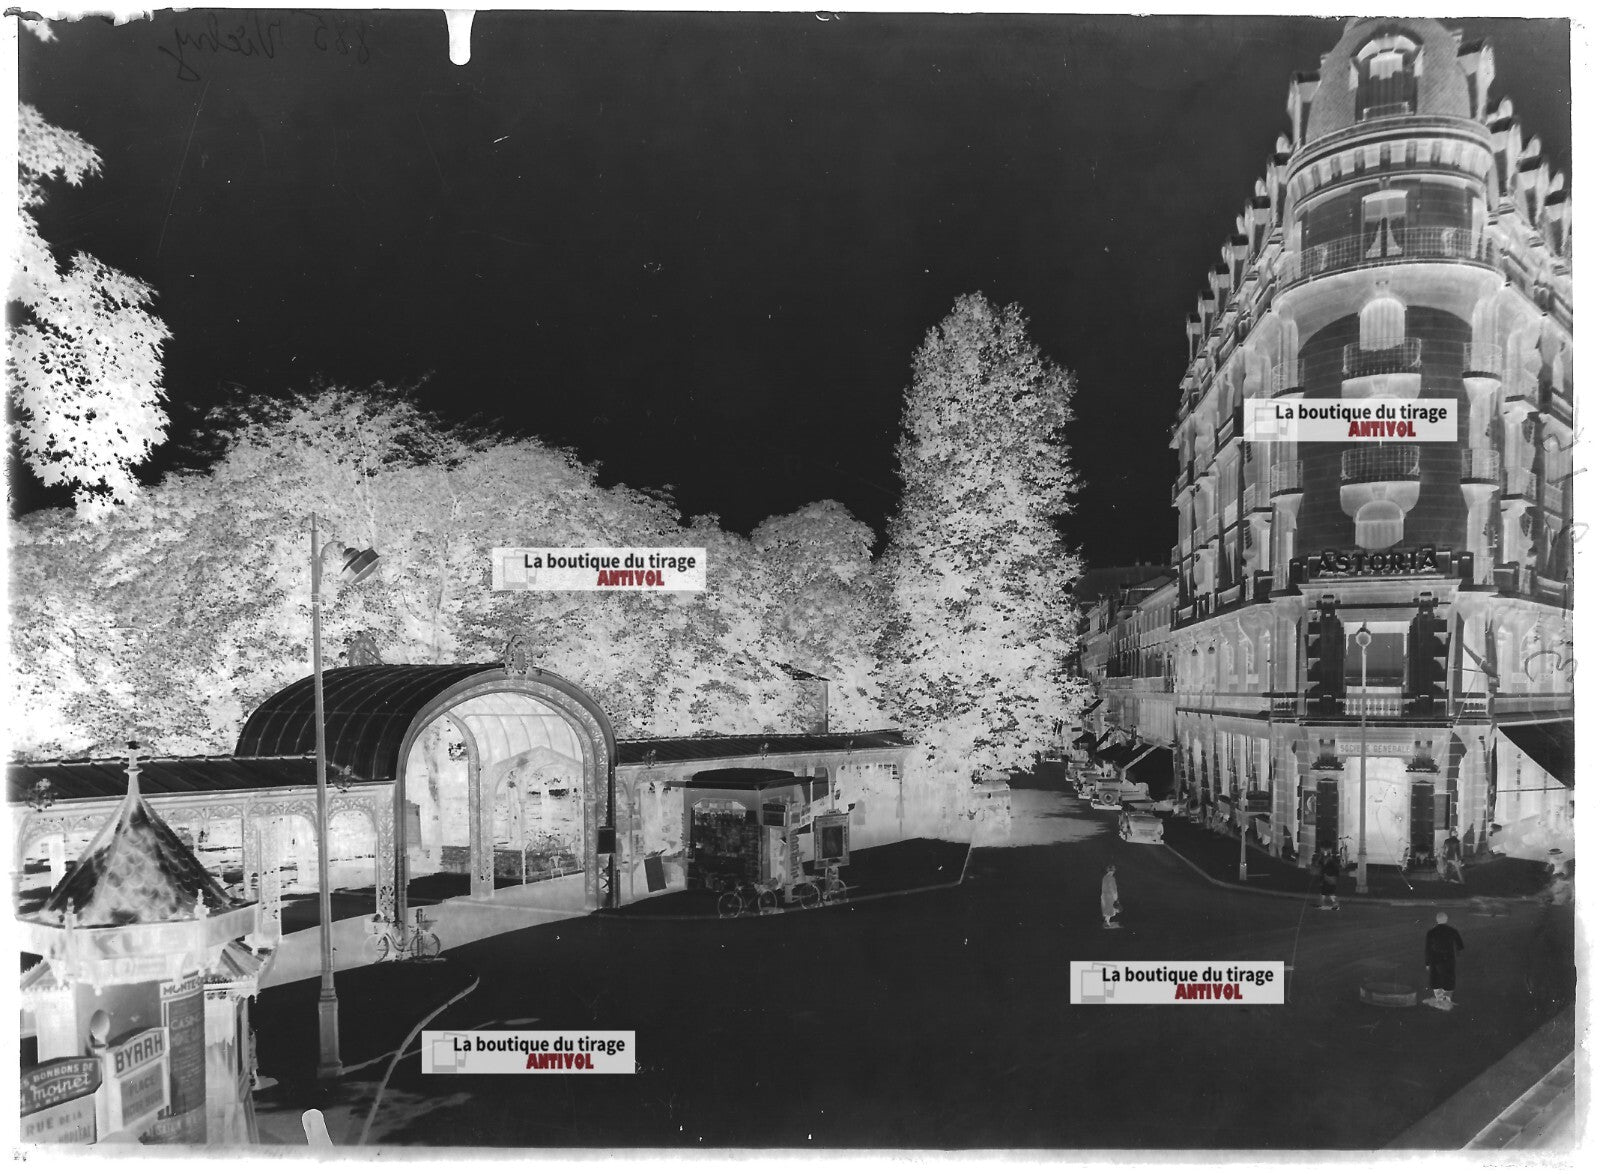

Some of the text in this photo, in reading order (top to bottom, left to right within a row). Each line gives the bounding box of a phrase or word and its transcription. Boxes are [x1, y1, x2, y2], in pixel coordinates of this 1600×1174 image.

[1318, 549, 1439, 573] ASTORIA
[114, 1033, 163, 1074] BYRRH
[25, 1116, 55, 1137] RUE
